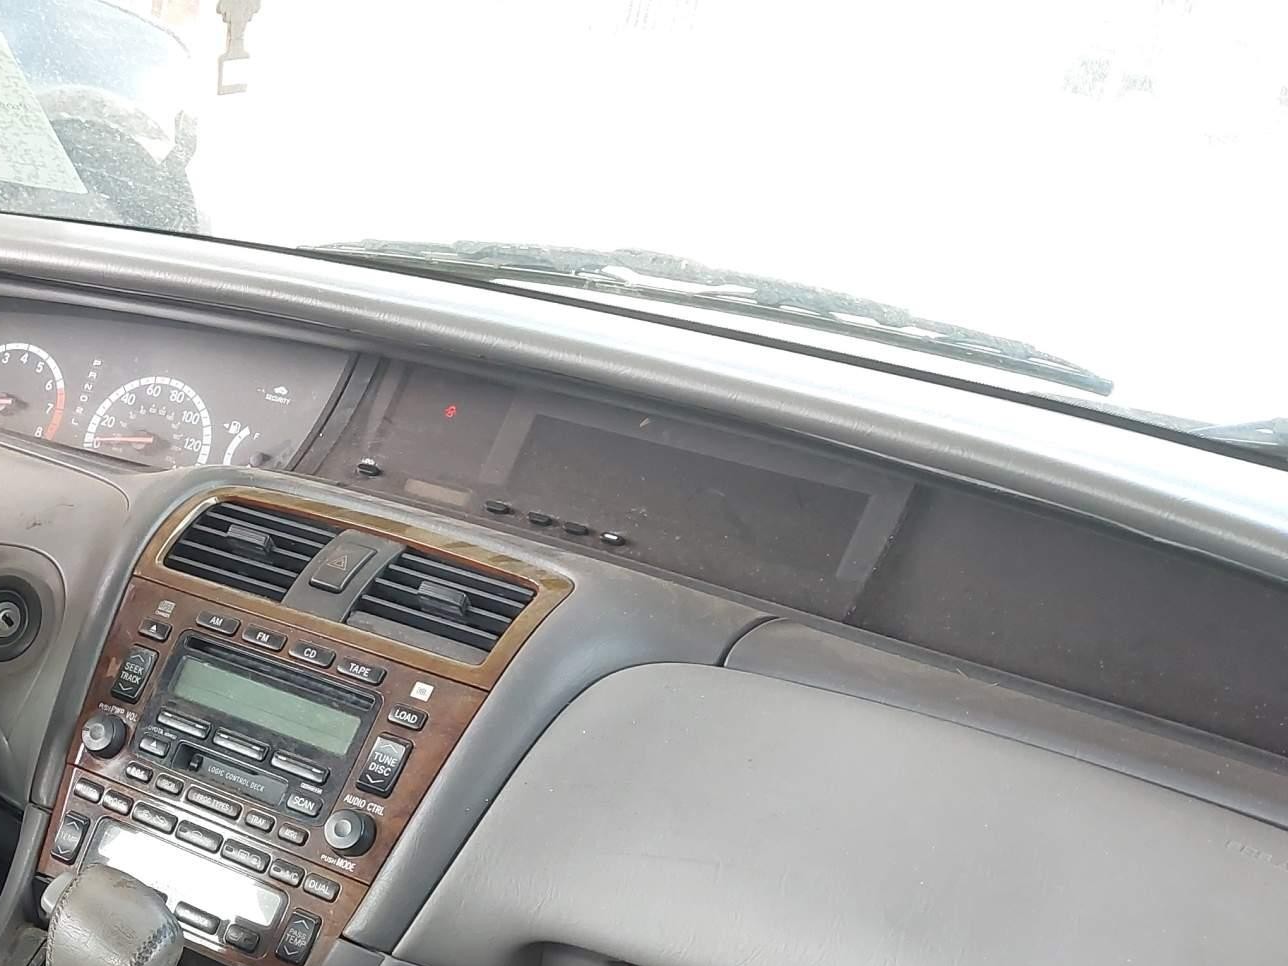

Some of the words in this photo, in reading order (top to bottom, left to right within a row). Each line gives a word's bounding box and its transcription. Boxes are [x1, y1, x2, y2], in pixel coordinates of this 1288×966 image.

[2, 353, 11, 364] 3
[20, 353, 29, 364] 4
[36, 362, 45, 374] 5
[45, 379, 54, 391] 6
[147, 384, 162, 397] 60
[121, 393, 136, 406] 40
[169, 390, 185, 404] 80
[265, 393, 292, 405] SECURITY
[46, 403, 54, 414] 7
[100, 415, 116, 428] 20
[181, 410, 200, 425] 100
[34, 426, 43, 438] 8
[252, 432, 261, 440] F
[184, 437, 202, 452] 120
[210, 616, 224, 627] AM
[256, 631, 270, 642] FM
[303, 647, 317, 659] CD
[124, 661, 145, 676] SEEK
[348, 662, 372, 678] TAPE
[120, 670, 142, 685] TRACK
[125, 711, 138, 722] VOL
[394, 709, 418, 724] LOAD
[373, 751, 398, 767] TUNE
[368, 761, 392, 777] DISC
[207, 764, 225, 777] LOGIC
[225, 772, 250, 787] CONTROL
[249, 783, 266, 793] DECK
[293, 795, 316, 811] SCAN
[343, 794, 366, 809] AUDIO
[366, 803, 385, 816] CTRL
[320, 853, 337, 865] PUSH
[336, 857, 357, 873] MODE
[308, 879, 331, 894] DUAL
[285, 933, 307, 948] TEMP
[289, 928, 307, 940] PASS
